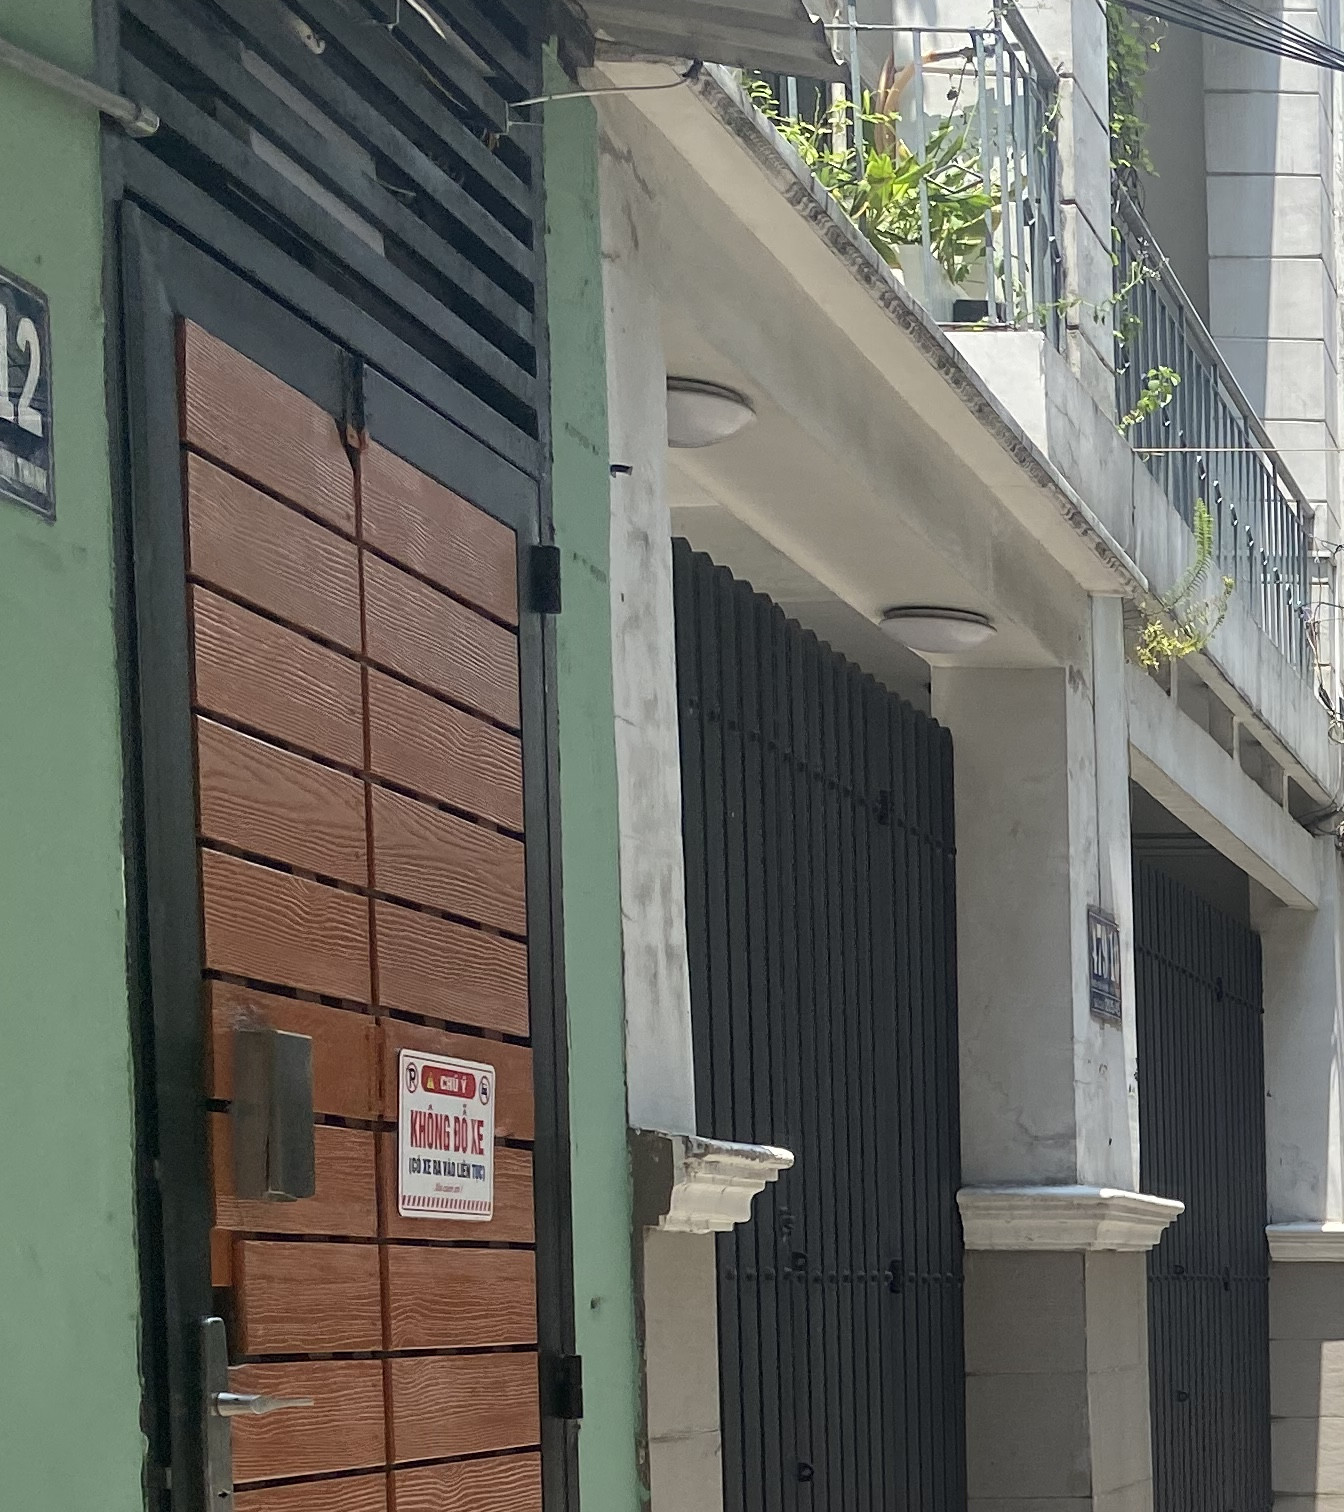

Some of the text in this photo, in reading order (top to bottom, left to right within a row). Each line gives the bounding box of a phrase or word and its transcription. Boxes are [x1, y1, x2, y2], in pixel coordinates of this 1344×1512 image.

[410, 1103, 485, 1155] KHÔNG ĐỖ XE
